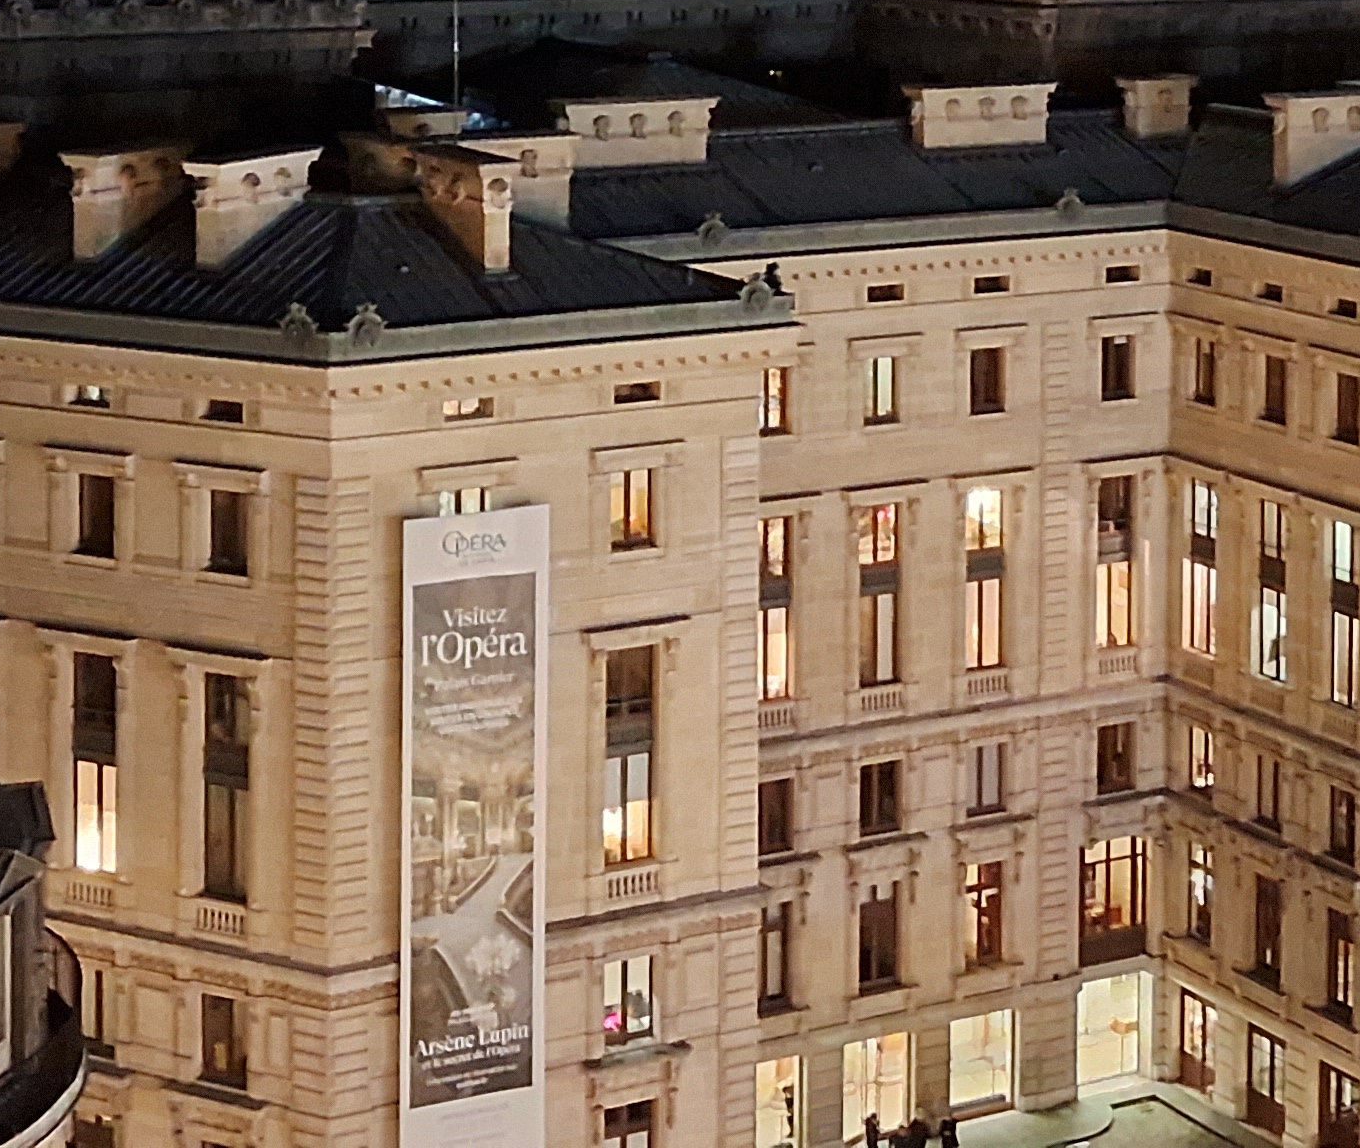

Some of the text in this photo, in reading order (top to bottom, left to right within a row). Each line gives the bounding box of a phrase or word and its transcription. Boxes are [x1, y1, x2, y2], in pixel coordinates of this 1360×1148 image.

[442, 605, 507, 628] Visitez
[415, 1022, 529, 1059] Arsène Lupin
